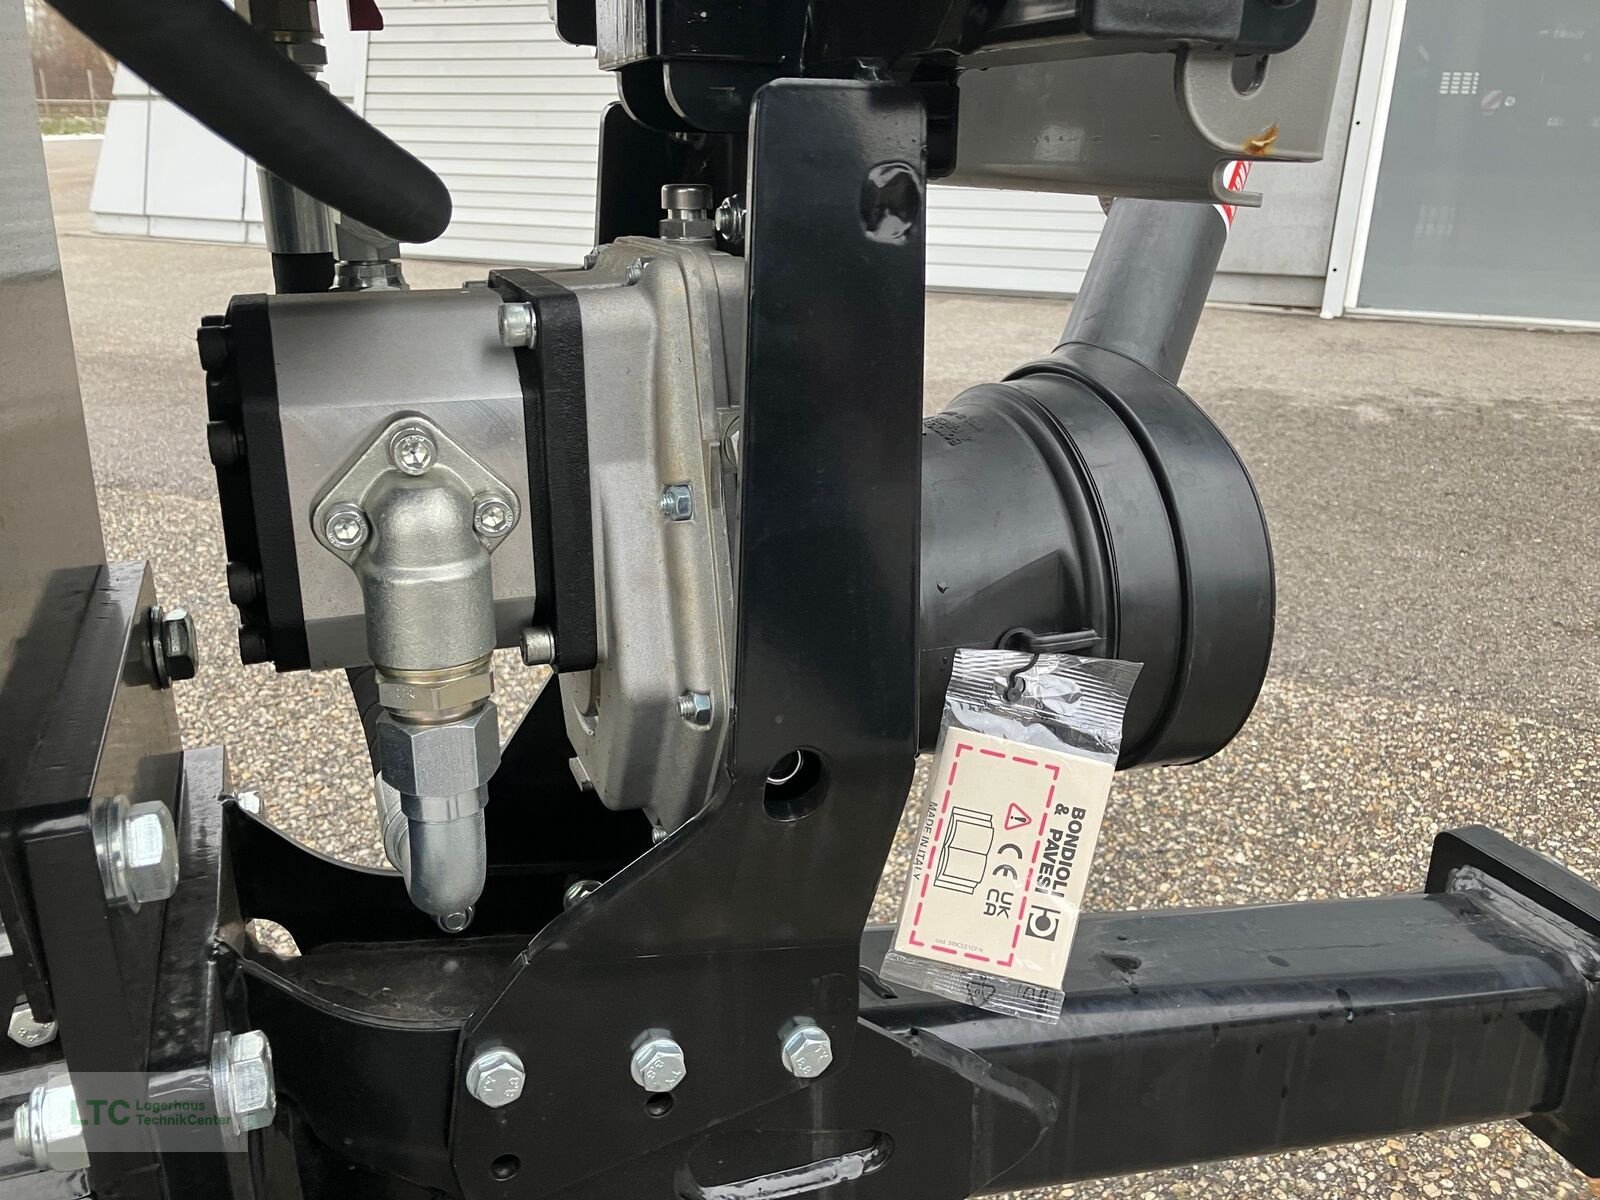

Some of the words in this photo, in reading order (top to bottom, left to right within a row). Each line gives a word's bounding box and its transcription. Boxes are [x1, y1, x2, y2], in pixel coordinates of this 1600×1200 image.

[924, 801, 938, 834] MADE
[1054, 803, 1070, 815] &
[920, 835, 930, 848] IN
[1051, 806, 1087, 898] BONDIOLI
[913, 848, 927, 880] ITALY
[992, 843, 1023, 880] CE
[1034, 828, 1064, 894] PAVESI
[983, 888, 1000, 916] CA
[996, 891, 1015, 919] UK
